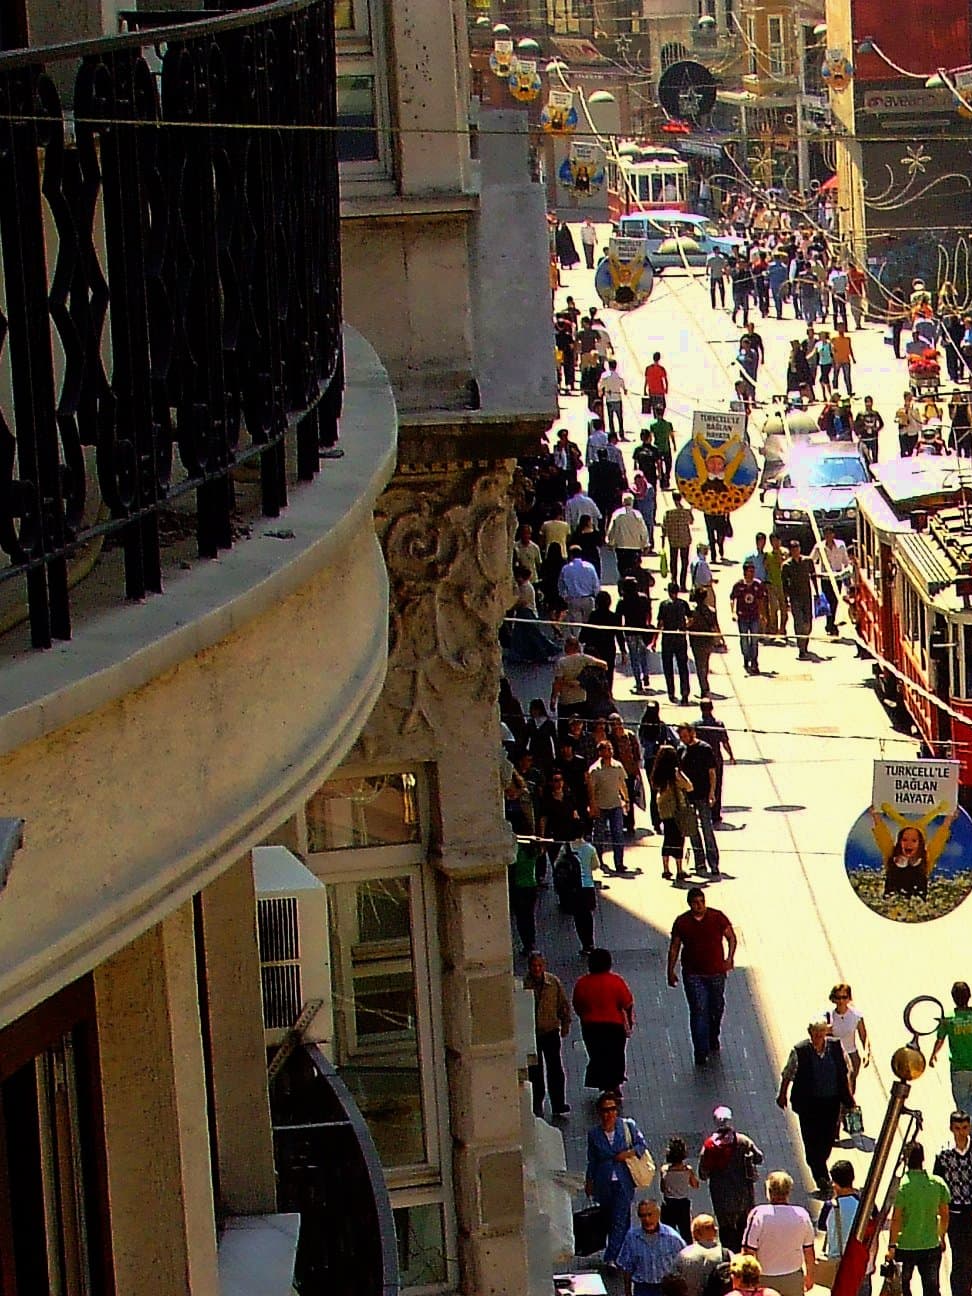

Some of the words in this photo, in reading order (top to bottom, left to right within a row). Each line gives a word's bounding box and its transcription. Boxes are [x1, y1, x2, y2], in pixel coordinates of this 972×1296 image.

[885, 765, 950, 778] TURKCELL'LE
[895, 777, 938, 791] BAĞLAN
[895, 792, 935, 805] HAYATA
